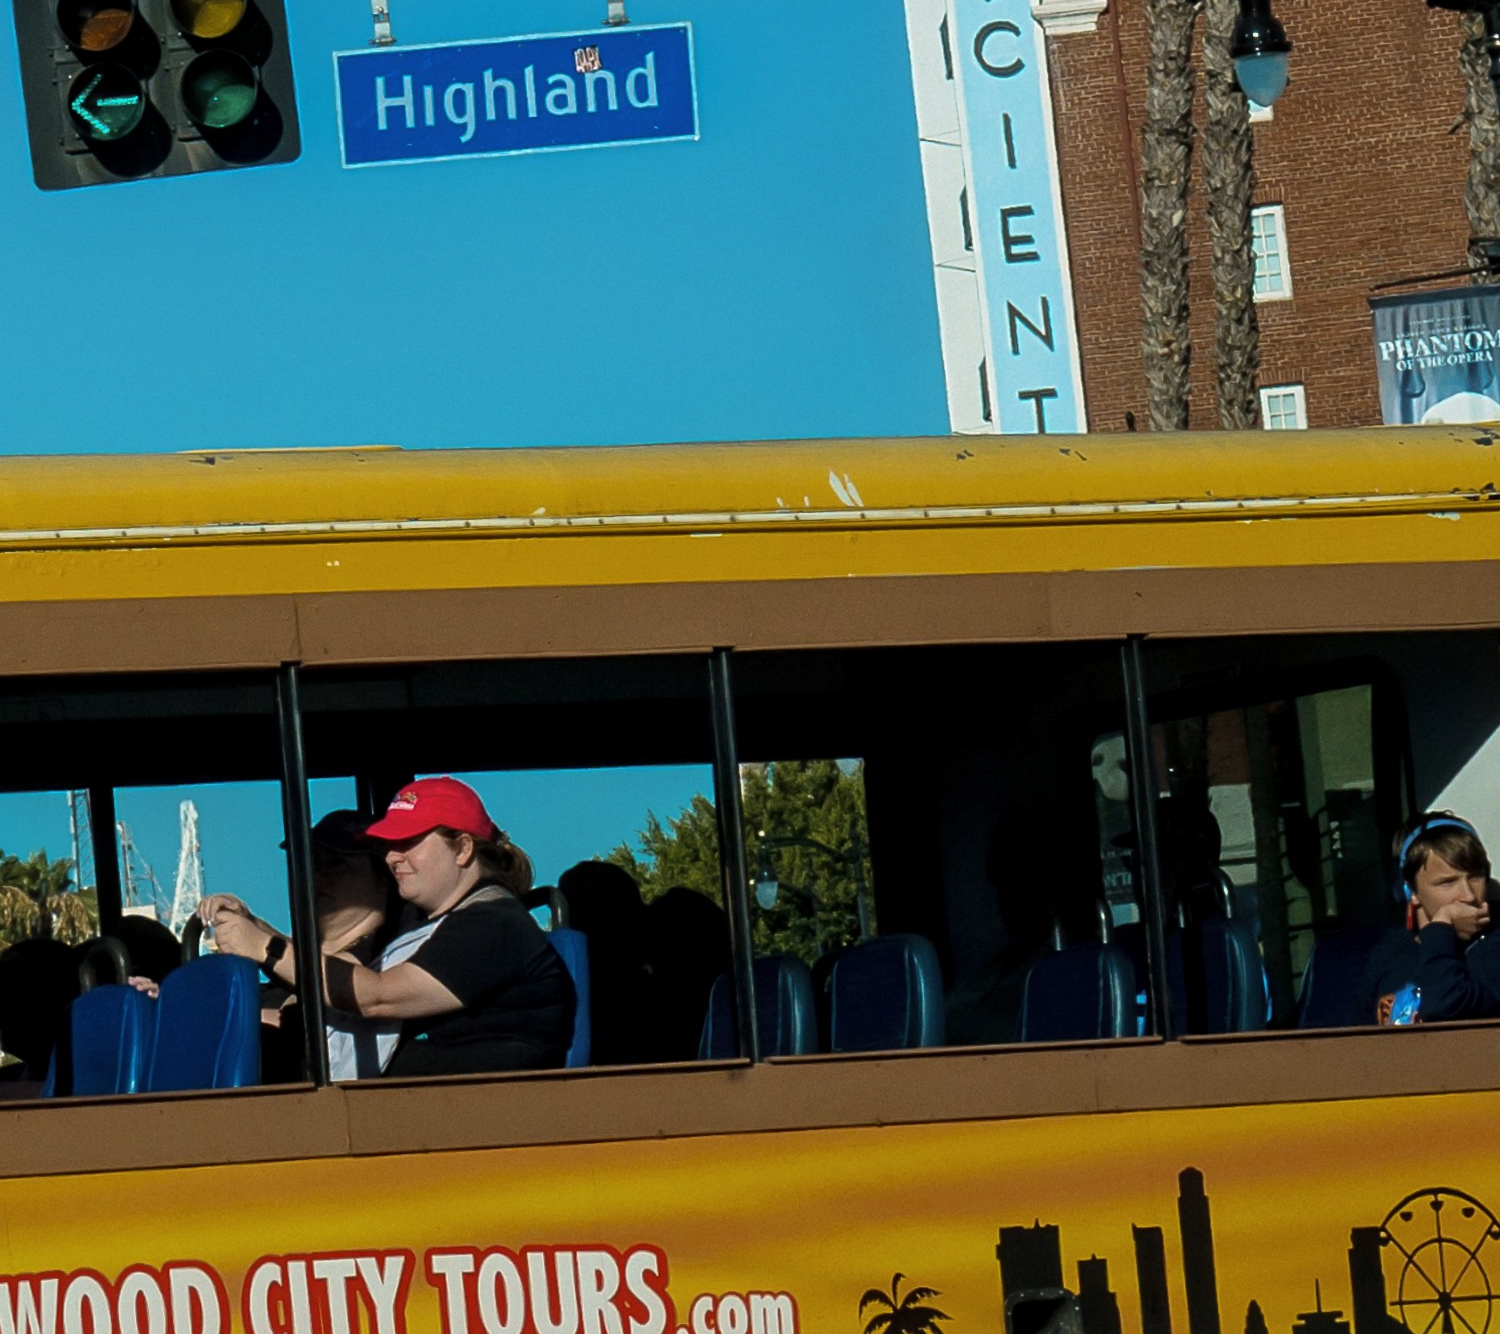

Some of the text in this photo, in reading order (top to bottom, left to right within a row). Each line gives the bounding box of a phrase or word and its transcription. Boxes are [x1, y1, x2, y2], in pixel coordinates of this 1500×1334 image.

[374, 50, 660, 144] Highland
[1395, 350, 1494, 372] OF THE OPERA
